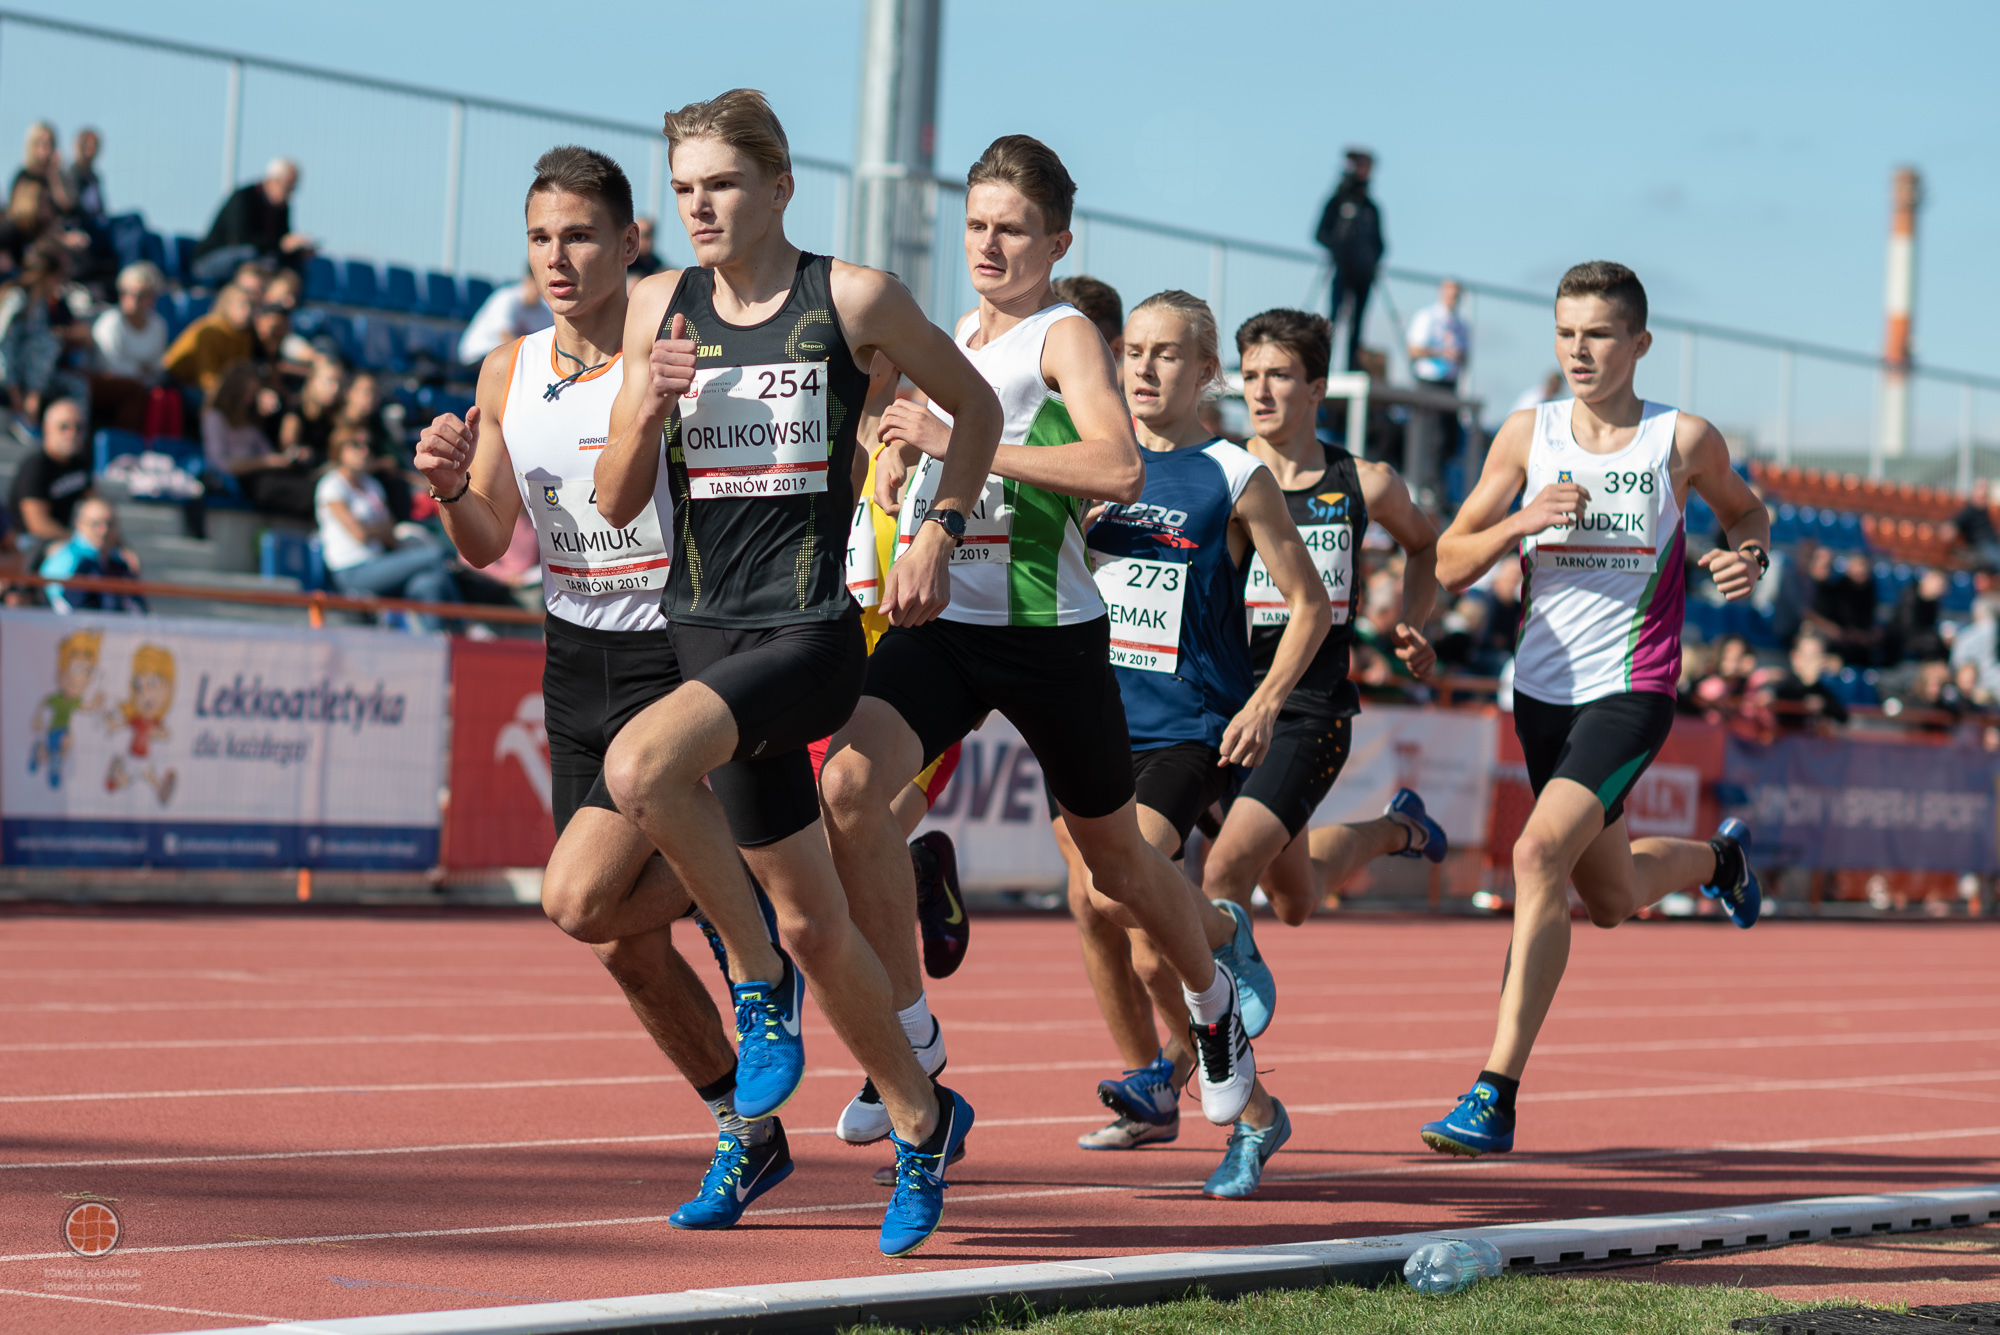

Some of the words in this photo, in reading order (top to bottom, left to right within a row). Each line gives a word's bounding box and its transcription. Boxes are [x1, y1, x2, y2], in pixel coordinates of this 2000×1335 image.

[758, 368, 820, 399] 254
[579, 437, 608, 445] PARKIE
[687, 420, 821, 450] ORLIKOWSKI
[709, 476, 768, 495] TARNÓW
[773, 477, 807, 492] 2019
[1604, 471, 1654, 494] 398
[550, 527, 643, 553] KLIMIUK
[1305, 529, 1350, 552] 480
[960, 548, 990, 560] 2019
[1555, 555, 1608, 569] TARNÓW
[1611, 557, 1640, 569] 2019
[565, 578, 613, 593] TARNÓW
[617, 575, 649, 589] 2019
[1126, 563, 1180, 592] 273
[1105, 602, 1168, 630] EMAK
[1261, 612, 1290, 622] TARN
[1129, 653, 1157, 667] 2019
